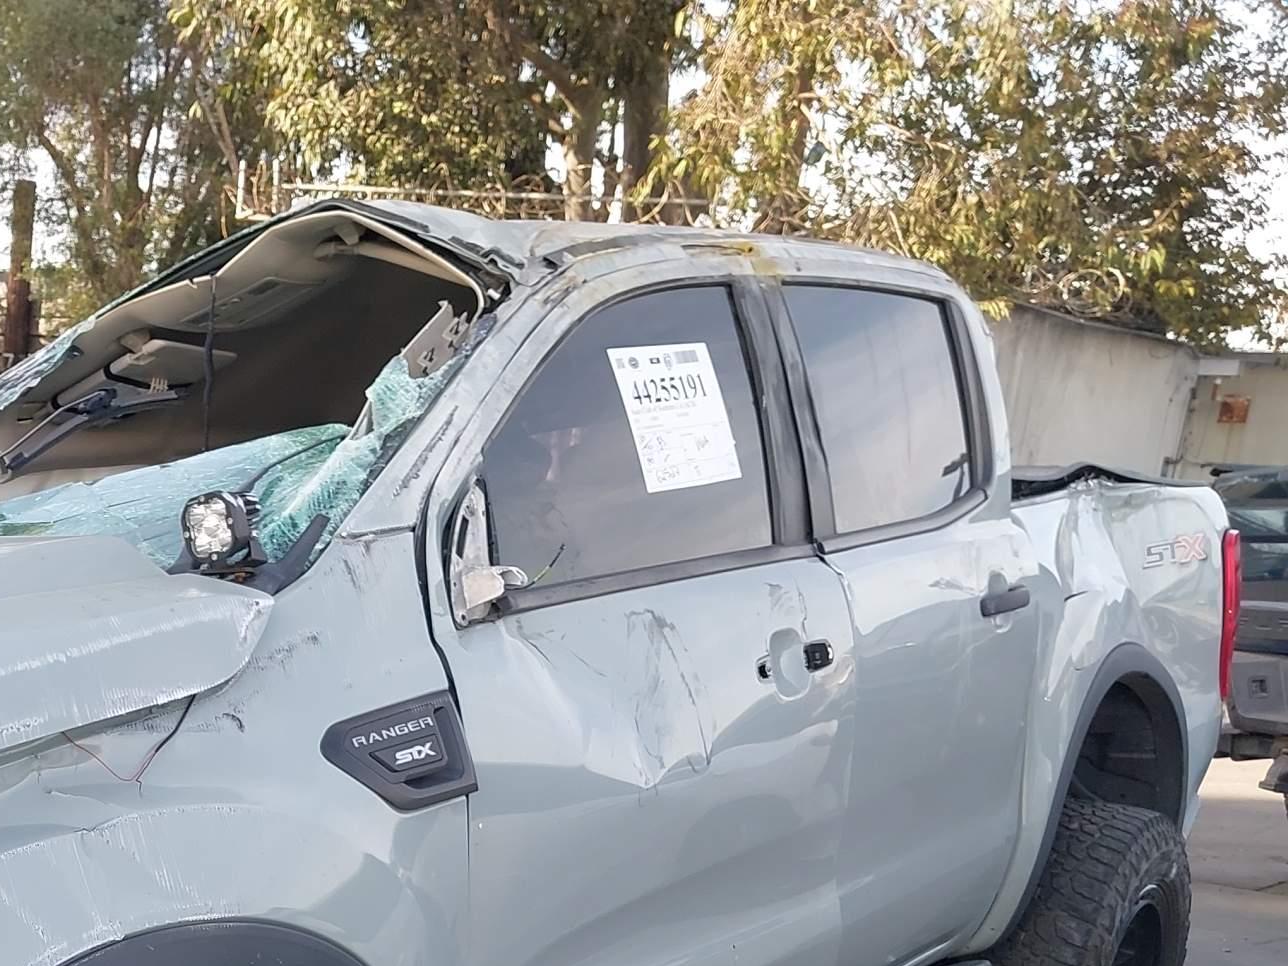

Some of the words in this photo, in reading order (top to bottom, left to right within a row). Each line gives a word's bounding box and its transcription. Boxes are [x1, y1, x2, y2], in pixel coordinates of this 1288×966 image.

[632, 373, 707, 405] 44255191
[1142, 532, 1208, 569] STX
[352, 717, 434, 748] RANGER
[395, 741, 437, 766] STX
